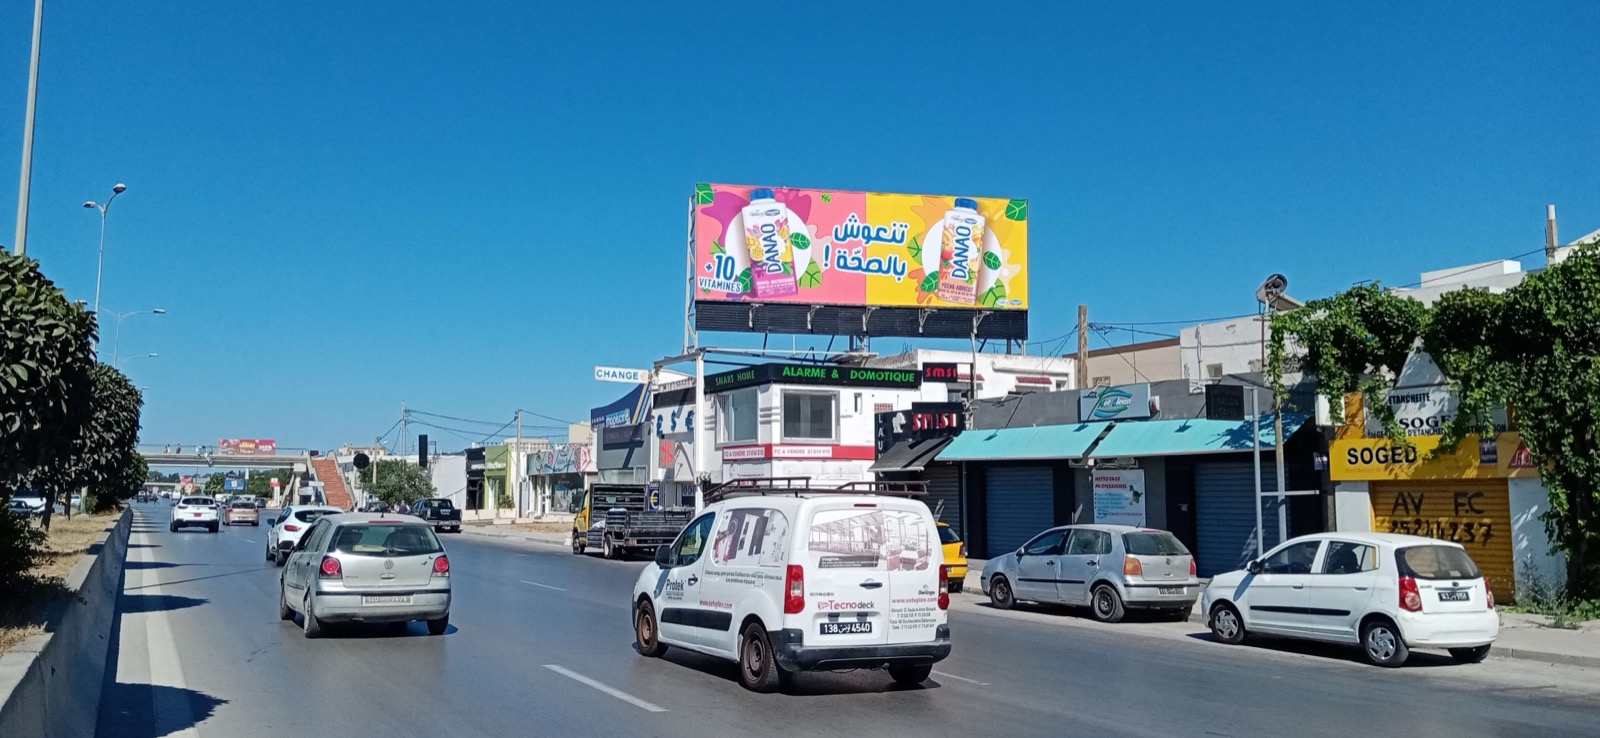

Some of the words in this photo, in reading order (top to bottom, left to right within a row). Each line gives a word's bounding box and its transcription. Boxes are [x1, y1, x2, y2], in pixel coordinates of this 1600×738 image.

[834, 214, 908, 244] تنعوش
[760, 223, 781, 273] DANAO
[951, 225, 971, 279] DANAO
[699, 278, 741, 292] VITAMINES
[596, 369, 639, 380] CHANGE
[715, 374, 734, 386] SMART
[737, 370, 755, 382] HOME
[782, 366, 827, 378] ALARME
[831, 369, 839, 379] &
[850, 369, 915, 382] DOMOTIQUE
[1388, 392, 1431, 404] ETANCHEITE
[1347, 446, 1418, 465] SOGED
[1391, 491, 1424, 516] AV
[665, 579, 684, 591] Protek
[824, 624, 838, 633] 138
[851, 623, 870, 632] 4540
